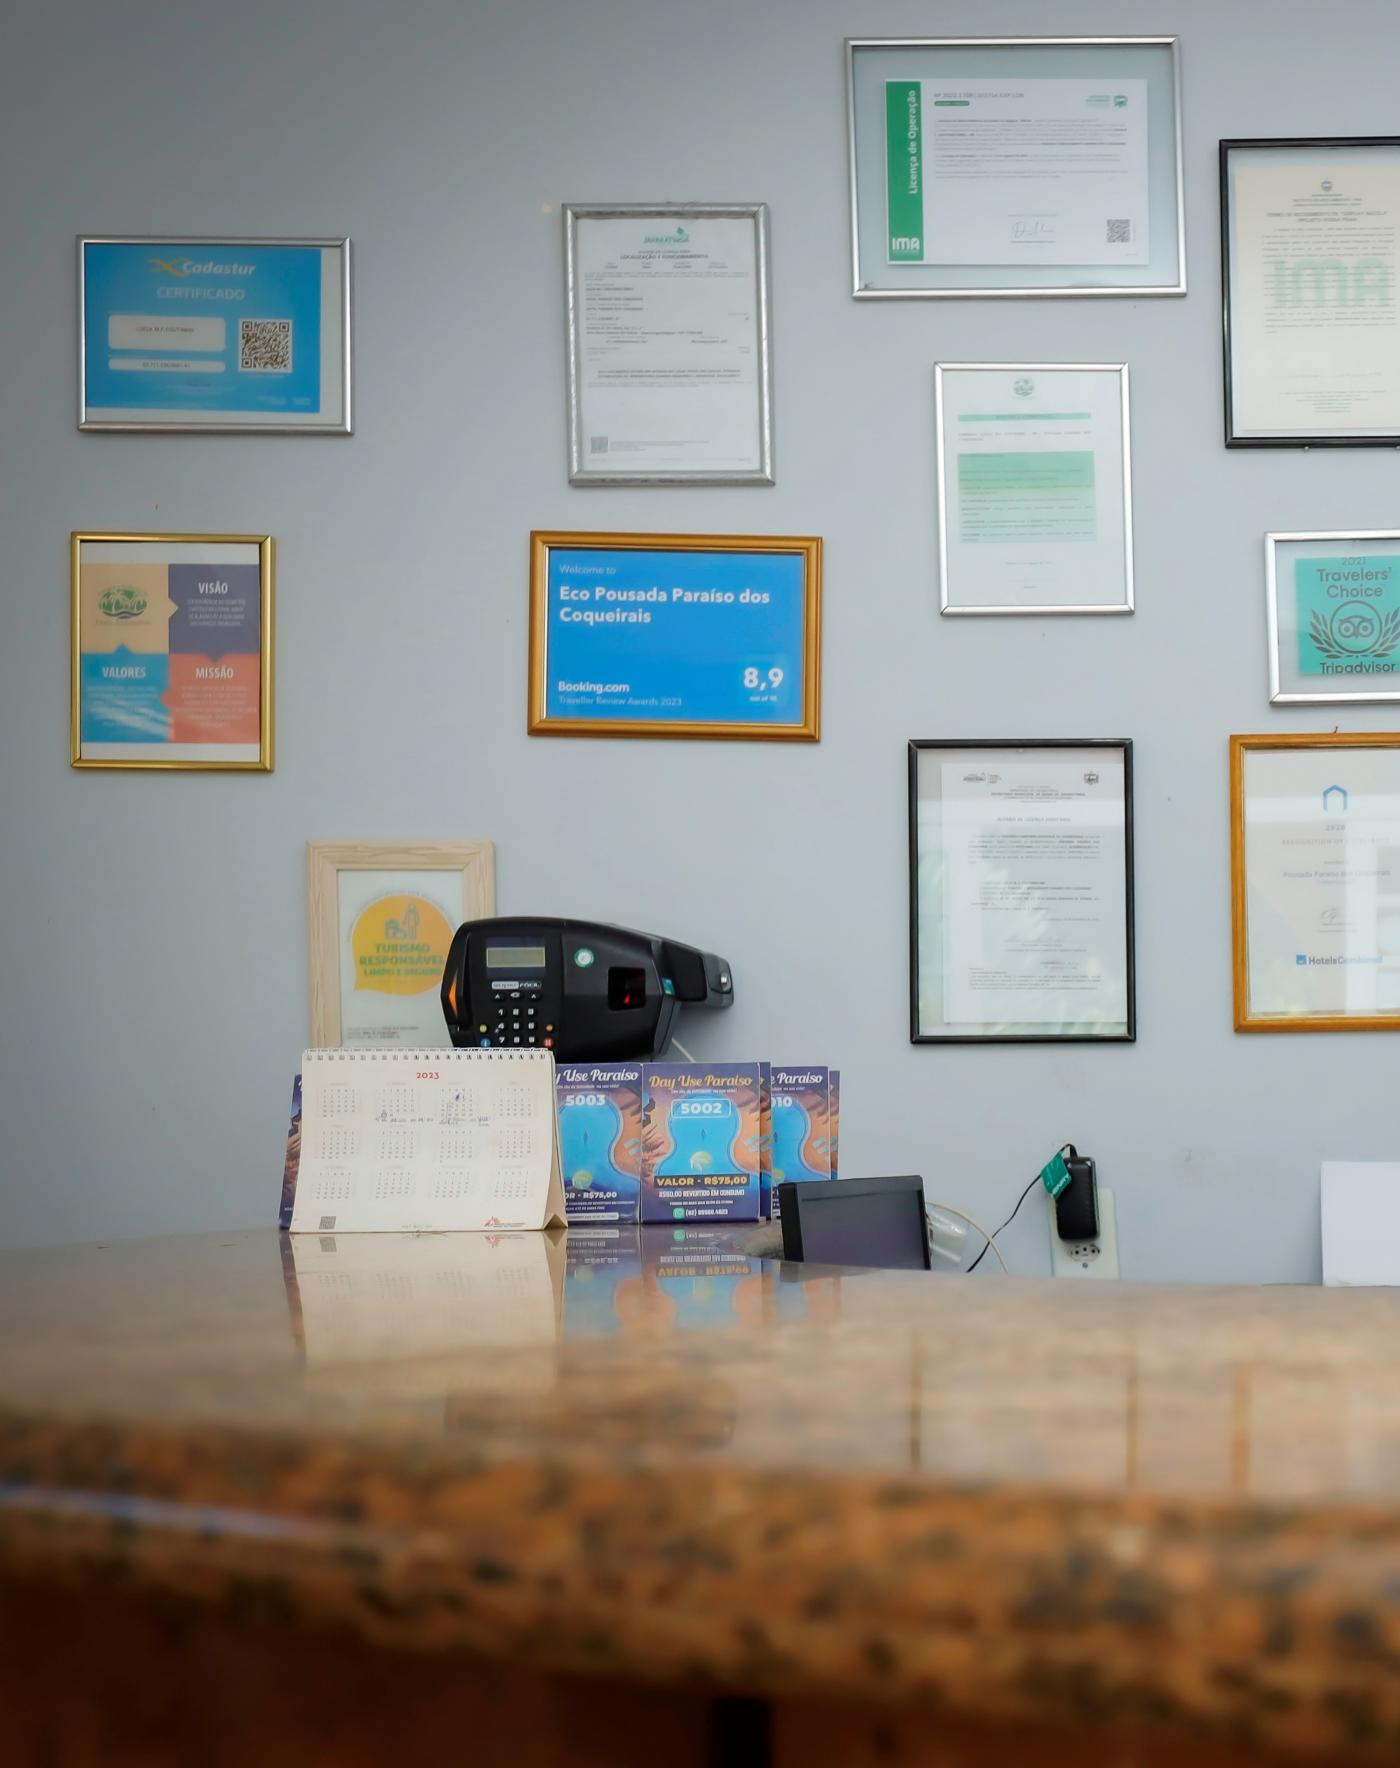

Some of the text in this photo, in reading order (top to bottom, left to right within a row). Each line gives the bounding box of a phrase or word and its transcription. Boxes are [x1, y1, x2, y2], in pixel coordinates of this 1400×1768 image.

[906, 89, 919, 195] Licença de Operação
[180, 260, 256, 276] Cadastur
[156, 286, 246, 300] CERTIFICADO
[559, 564, 616, 575] Welcome to
[198, 581, 228, 594] VISÃO
[1326, 584, 1383, 598] Choice
[559, 585, 770, 604] Eco Pousada Paraíso dos
[559, 606, 651, 626] Coqueirais
[102, 667, 146, 679] VALORES
[196, 666, 234, 679] MISSÃO
[1320, 661, 1396, 675] Tripadvisor
[743, 667, 784, 692] 8,9
[558, 681, 630, 694] Booking.com
[596, 697, 625, 706] Review
[627, 697, 659, 706] Awards
[374, 943, 430, 953] TURISMO
[416, 1071, 440, 1080] 2023
[563, 1069, 588, 1082] Use
[649, 1075, 675, 1090] Day
[678, 1075, 702, 1087] Use
[565, 1094, 606, 1106] 5003
[680, 1102, 723, 1114] 5002
[656, 1178, 695, 1187] VALOR
[703, 1176, 748, 1186] R$75,00
[583, 1191, 618, 1200] R$75,00
